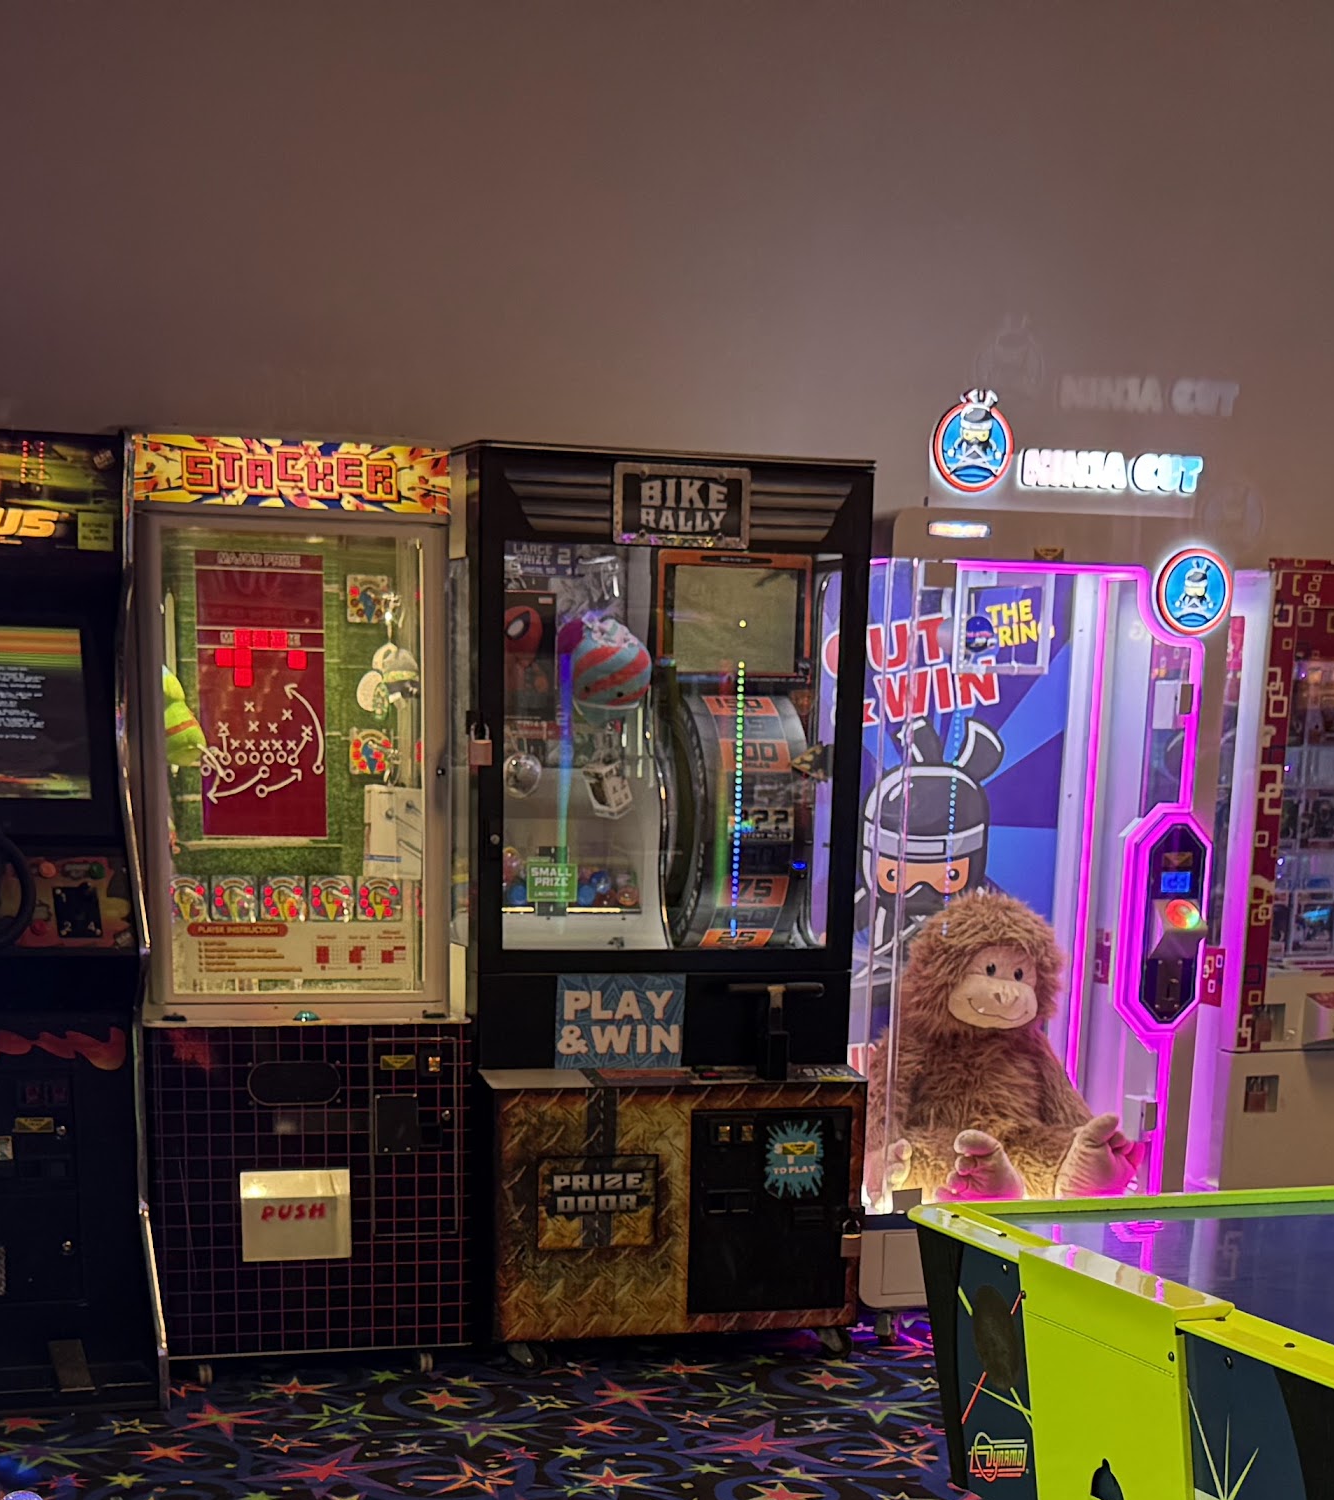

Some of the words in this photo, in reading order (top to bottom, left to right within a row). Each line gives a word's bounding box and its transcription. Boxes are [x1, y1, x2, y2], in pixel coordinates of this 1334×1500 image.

[183, 448, 397, 497] STACKER
[1021, 448, 1127, 491] NINJA
[1132, 452, 1204, 494] CUT
[640, 478, 729, 510] BIKE
[640, 508, 728, 533] RALLY
[216, 551, 264, 567] MAJOR
[264, 553, 301, 569] PRIZE
[557, 548, 572, 565] 2
[985, 598, 1034, 627] THE
[875, 657, 1000, 723] WIN
[530, 865, 572, 878] SMALL
[534, 876, 570, 888] PRIZE
[739, 878, 773, 900] 75
[196, 925, 226, 935] PLAYER
[562, 989, 675, 1022] PLAY
[773, 1166, 788, 1176] TO
[788, 1165, 817, 1175] PLAY
[552, 1172, 644, 1191] PRIZE
[261, 1202, 327, 1223] PUSH
[555, 1194, 639, 1213] DOOR
